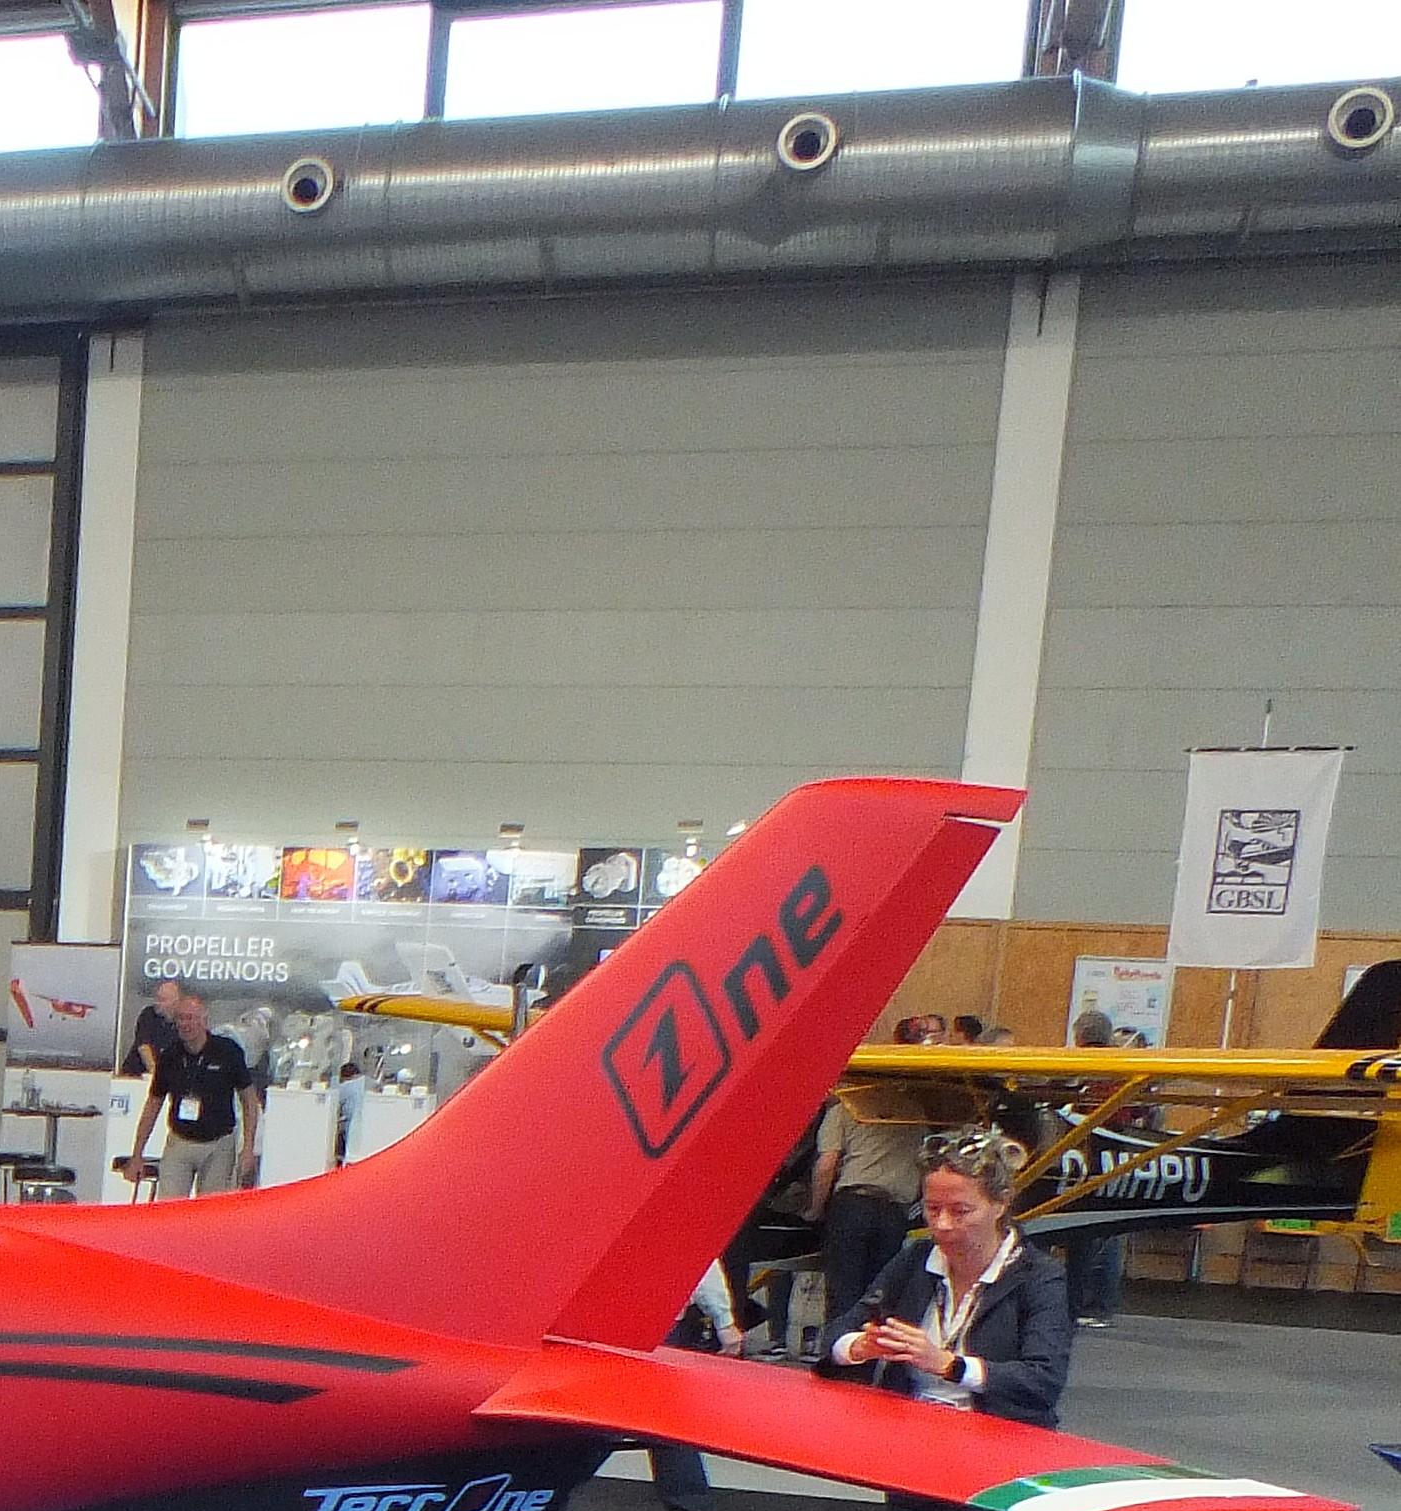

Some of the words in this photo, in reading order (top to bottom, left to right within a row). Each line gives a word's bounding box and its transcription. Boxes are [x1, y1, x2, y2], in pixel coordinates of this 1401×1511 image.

[1215, 889, 1282, 910] GBSL
[145, 934, 274, 958] PROPELLER
[143, 958, 290, 983] GOVERNORS
